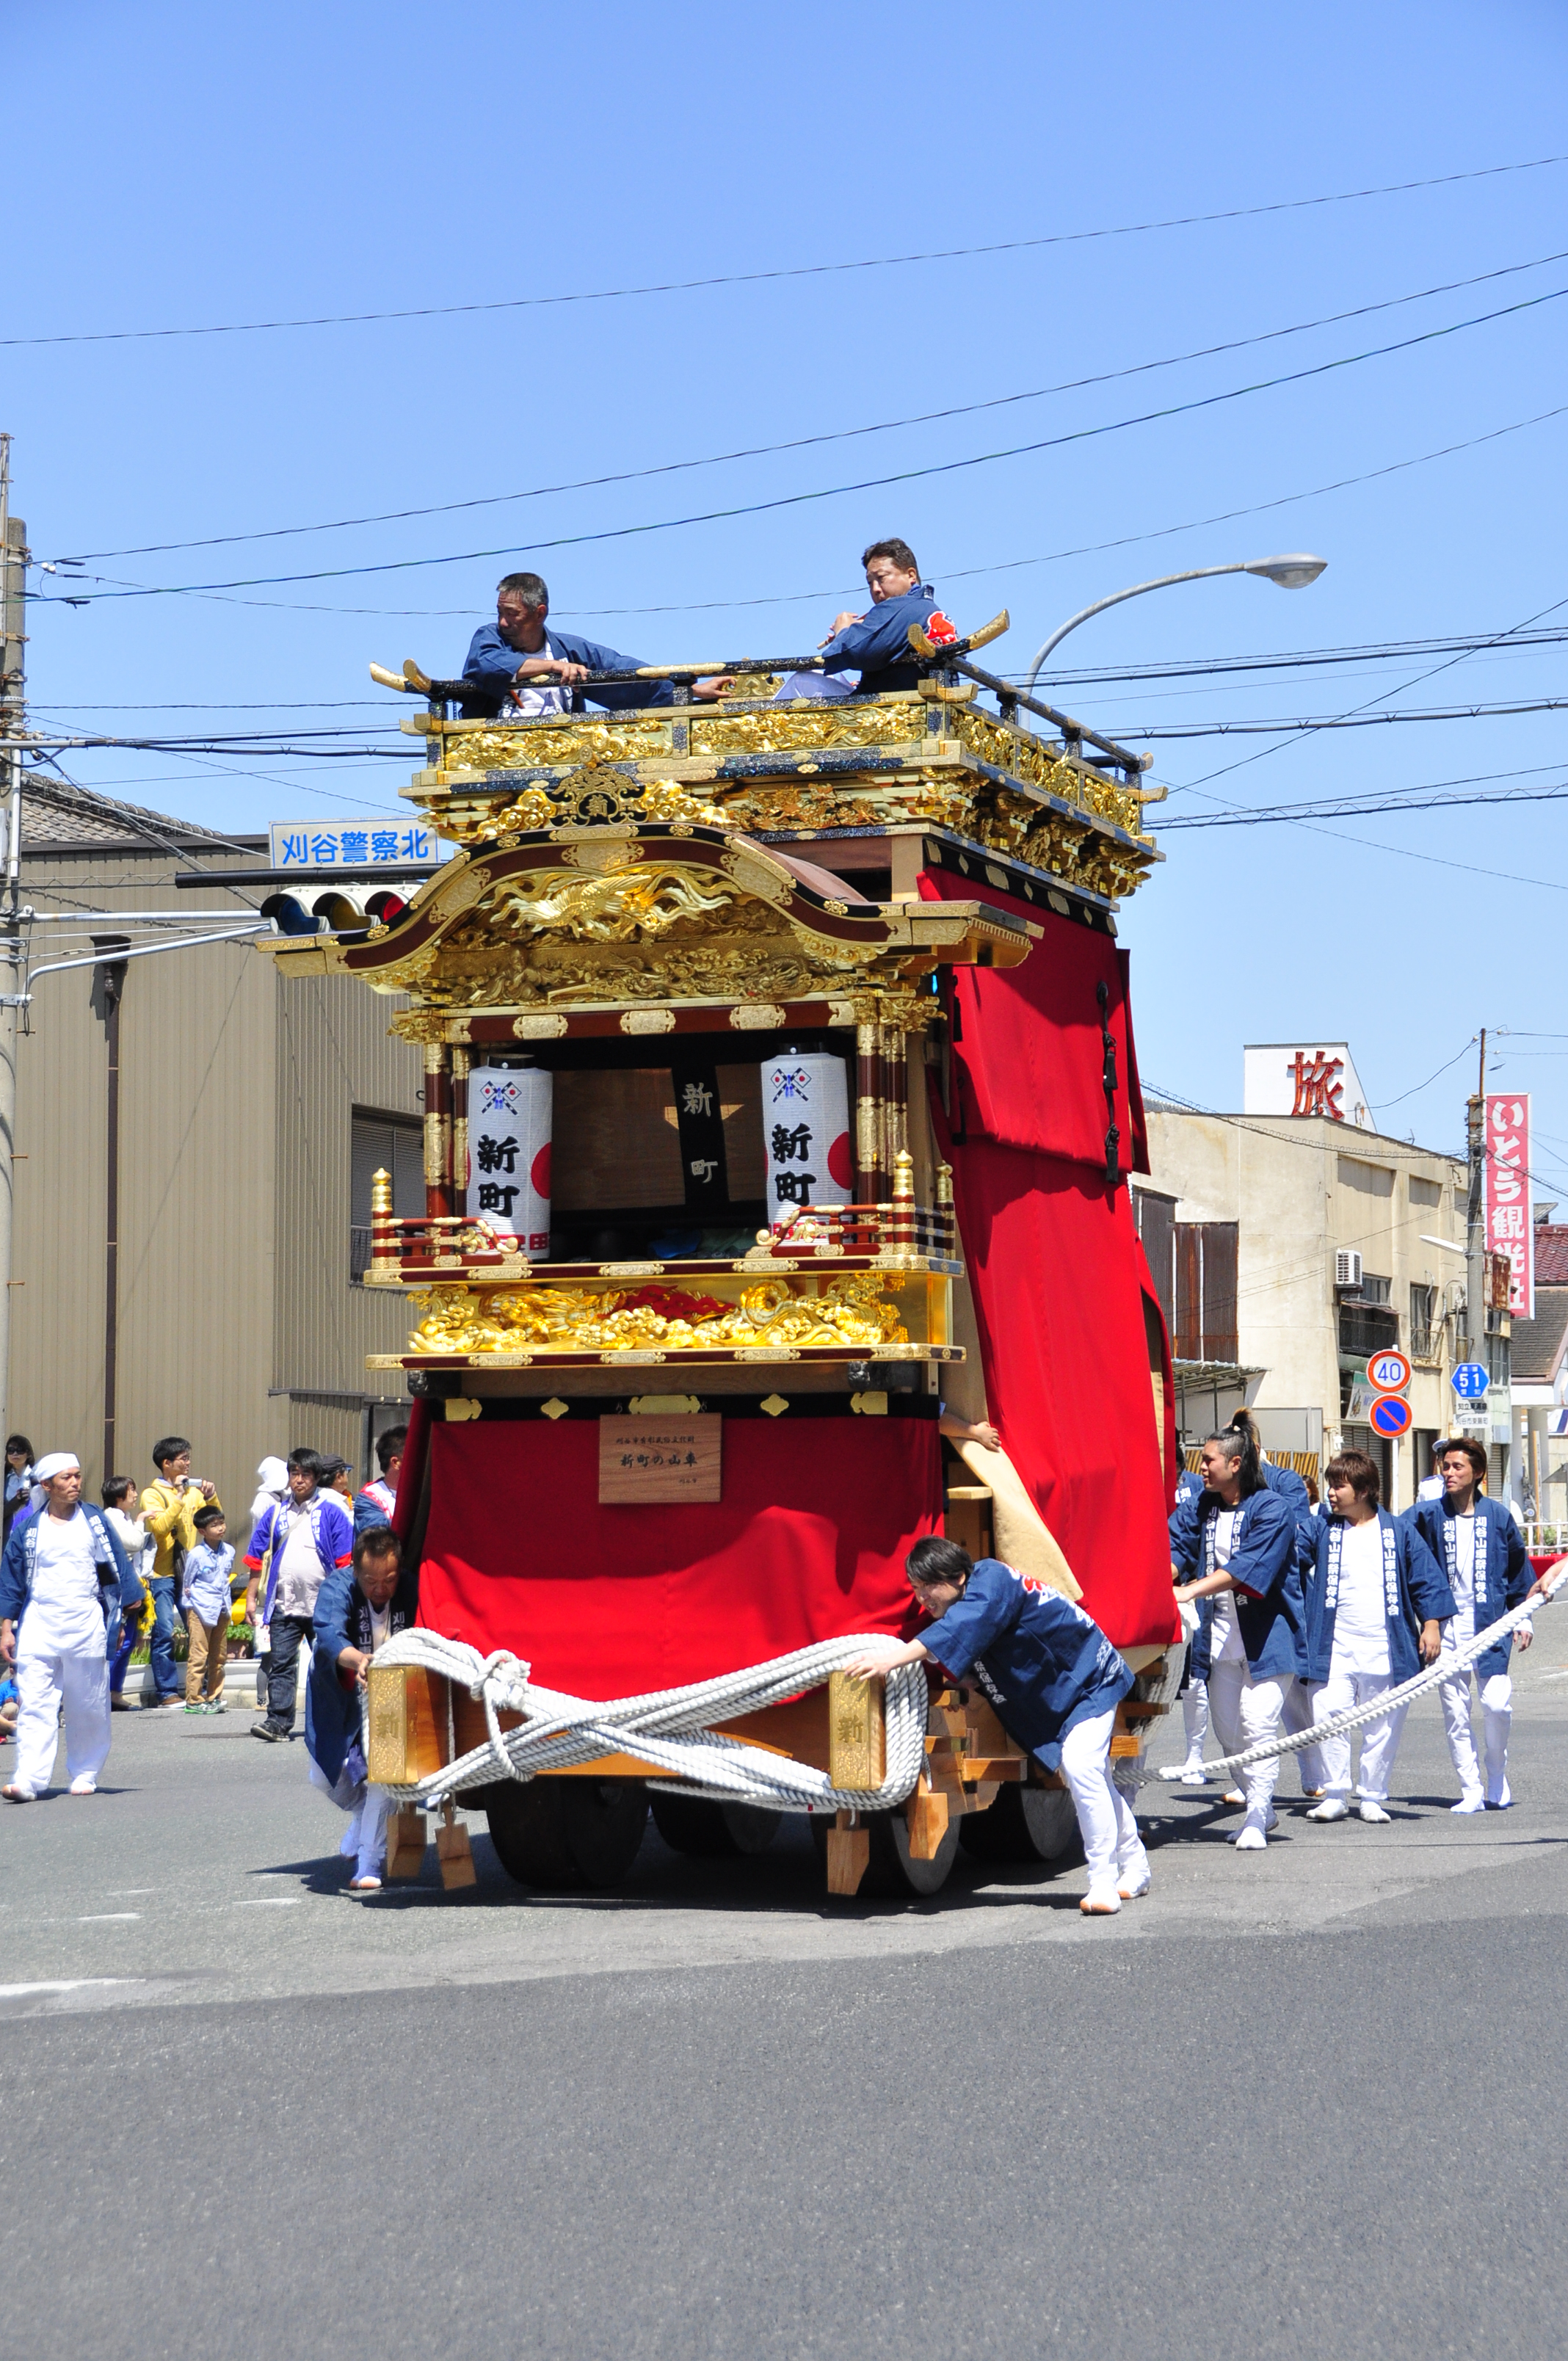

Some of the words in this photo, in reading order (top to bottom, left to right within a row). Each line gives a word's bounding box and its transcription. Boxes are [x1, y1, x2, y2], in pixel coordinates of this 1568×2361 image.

[282, 829, 429, 865] 刈谷警察北
[1287, 1051, 1346, 1120] 旅
[682, 1082, 718, 1183] 新町
[772, 1123, 816, 1205] 新町
[477, 1134, 520, 1217] 新町
[1378, 1363, 1401, 1381] 40
[1459, 1373, 1479, 1388] 51
[620, 1451, 697, 1468] 新町の山車
[1382, 1528, 1399, 1616] 刈谷山車祭保存会
[1475, 1516, 1487, 1603] 刈谷山車祭保存会
